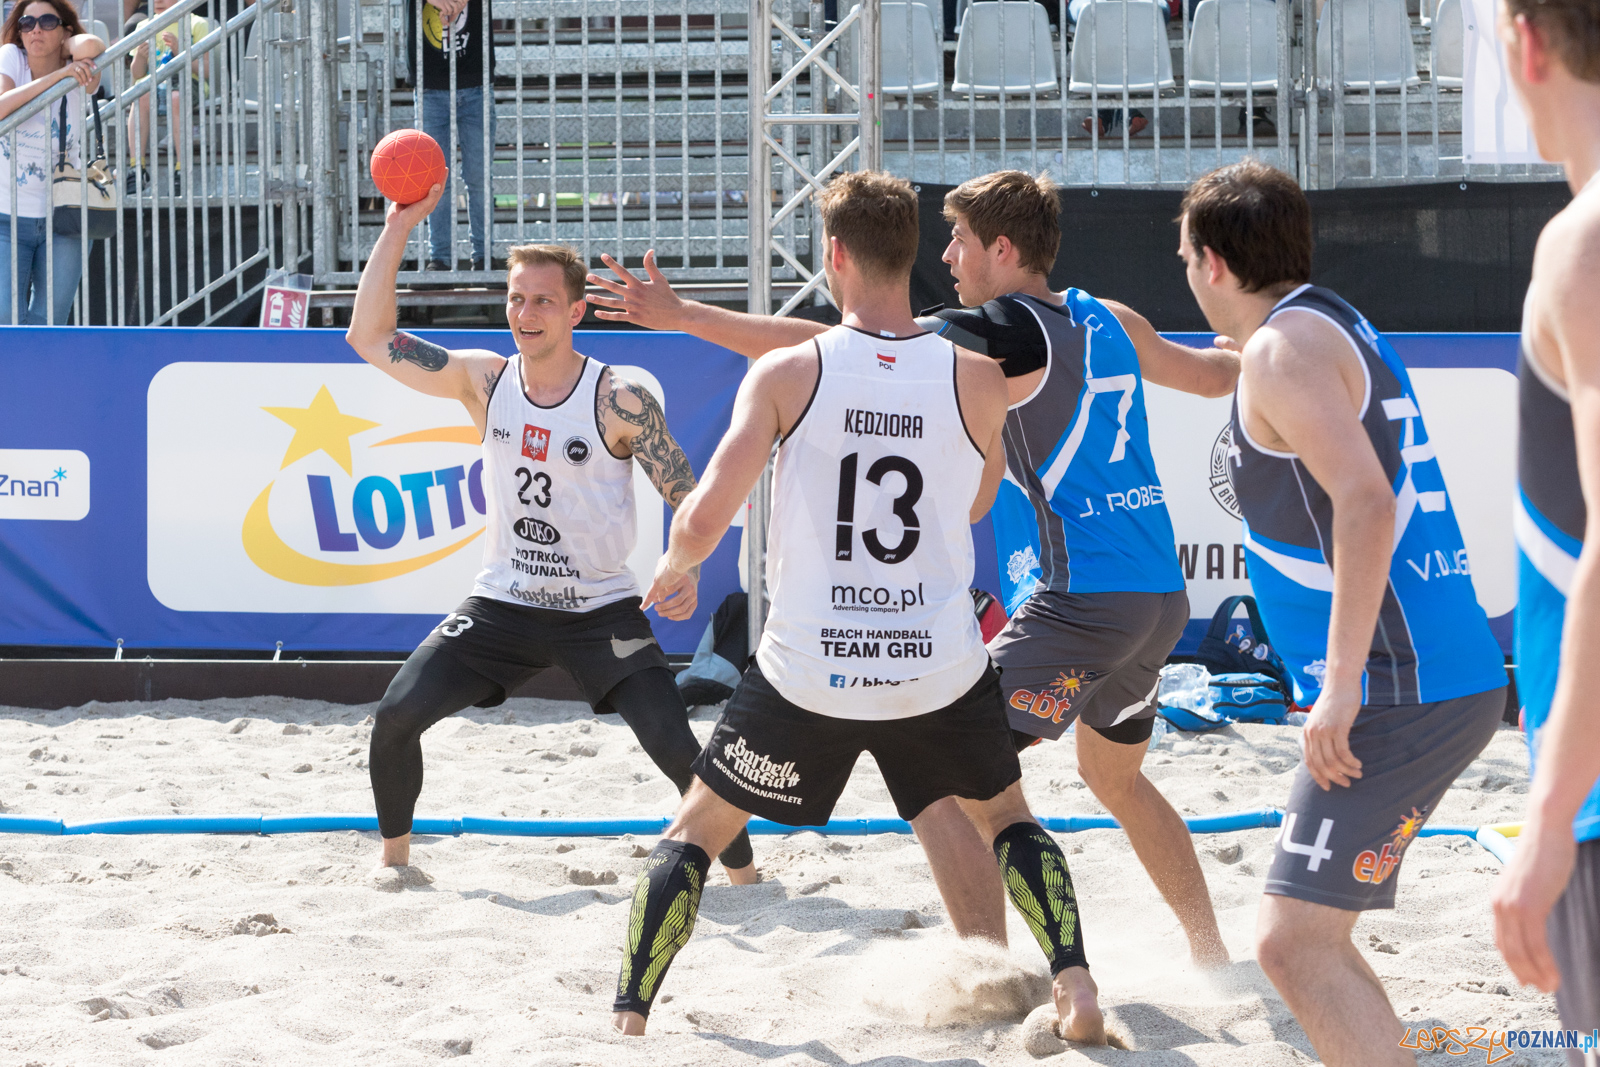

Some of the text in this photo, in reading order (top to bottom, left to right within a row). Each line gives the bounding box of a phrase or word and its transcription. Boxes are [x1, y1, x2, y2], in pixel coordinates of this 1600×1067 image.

[879, 361, 894, 371] POL
[844, 408, 923, 439] KĘDZIORA
[1085, 374, 1137, 464] 7
[514, 466, 552, 508] 23
[835, 451, 924, 565] 13
[1079, 497, 1101, 518] J.
[520, 519, 556, 543] JUKO
[832, 582, 924, 612] mco.pl
[833, 604, 900, 614] Advertising company
[821, 628, 932, 640] BEACH HANDBALL
[820, 640, 932, 659] TEAM GRU
[1270, 812, 1335, 872] 4
